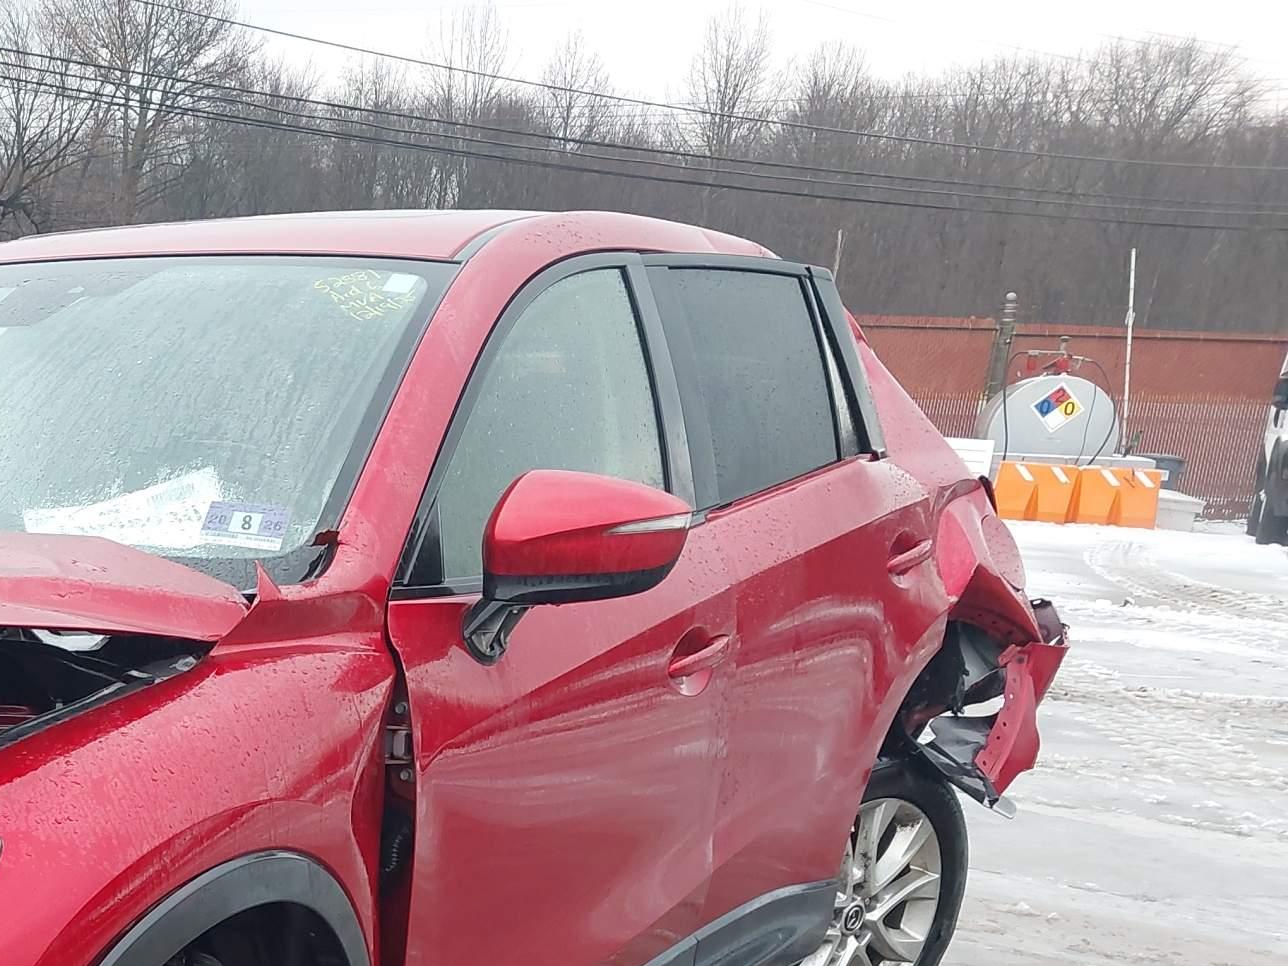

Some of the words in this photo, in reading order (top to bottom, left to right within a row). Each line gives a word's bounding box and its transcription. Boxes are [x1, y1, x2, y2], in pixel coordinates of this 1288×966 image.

[1055, 387, 1066, 403] 2
[1039, 399, 1051, 415] 0
[1063, 401, 1075, 416] 0
[207, 514, 228, 525] 20
[241, 514, 253, 530] 8
[263, 520, 283, 531] 26
